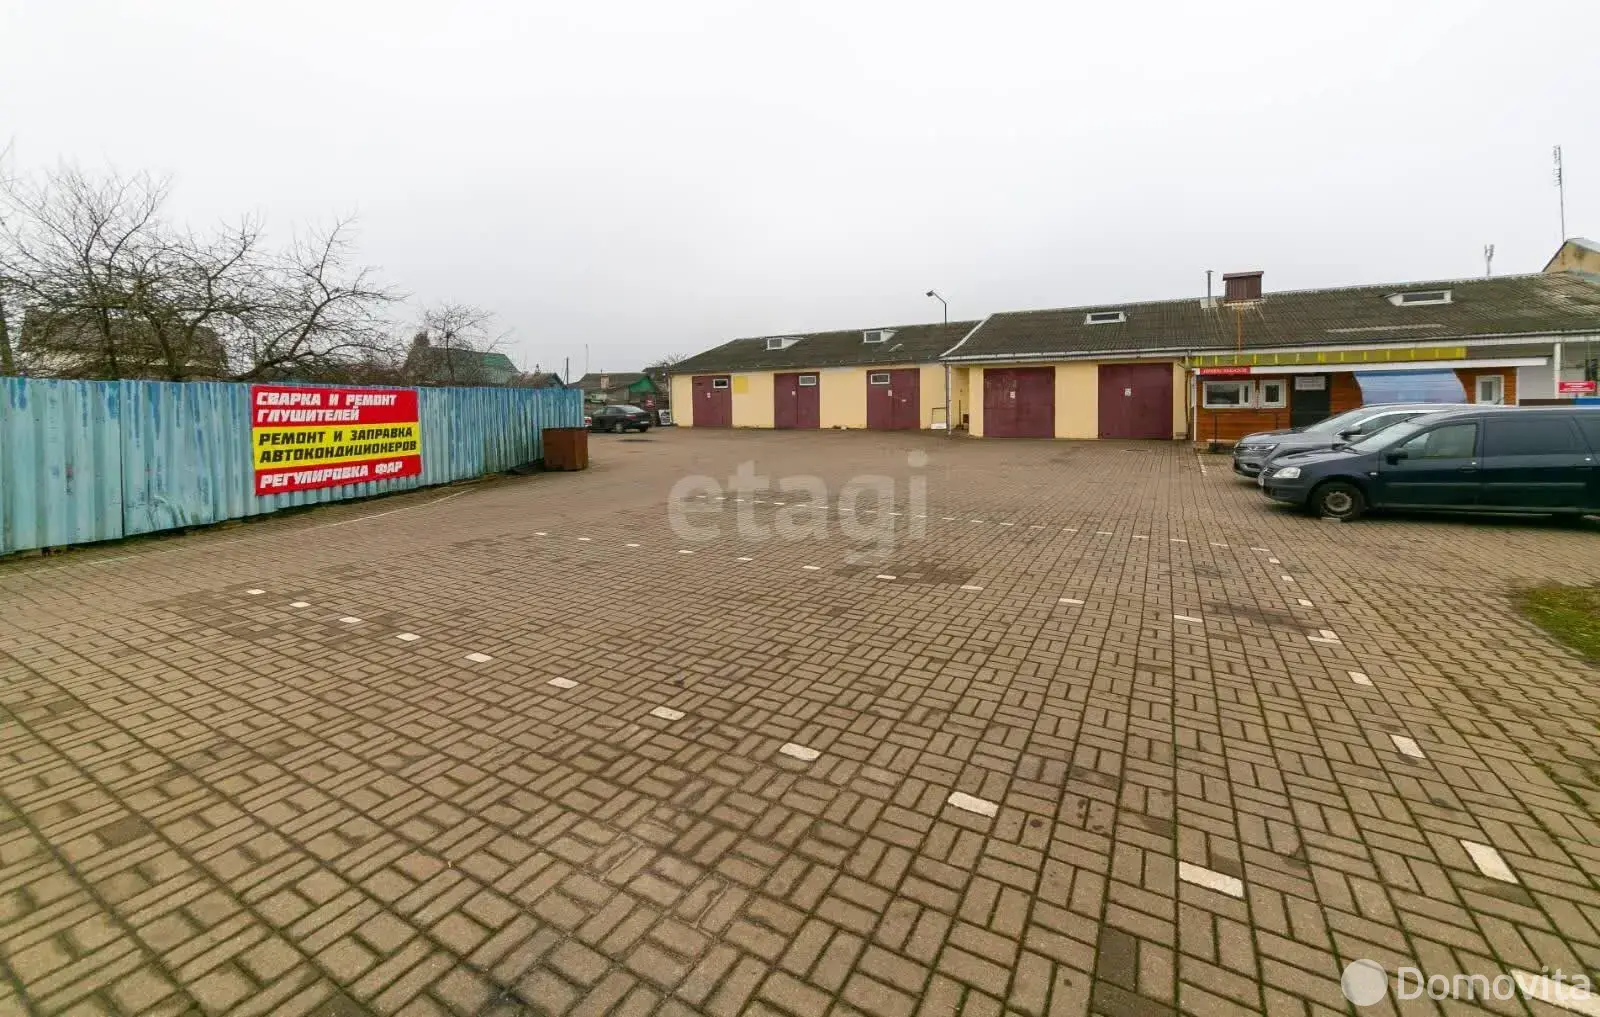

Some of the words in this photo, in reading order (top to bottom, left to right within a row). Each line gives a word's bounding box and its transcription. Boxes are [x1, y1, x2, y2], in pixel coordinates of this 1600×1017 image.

[256, 392, 321, 406] СВАРКА
[329, 393, 339, 406] И
[345, 394, 397, 406] РЕМОНТ
[257, 406, 360, 422] ГЛУШИТЕЛЕЙ
[258, 431, 326, 446] РЕМОНТ
[333, 430, 343, 442] И
[350, 427, 413, 441] ЗАПРАВКА
[259, 440, 417, 463] АВТОКОНДИЦИОНЕРОВ
[260, 464, 369, 489] РЕГУЛИРОВКА
[375, 461, 403, 475] ФАР
